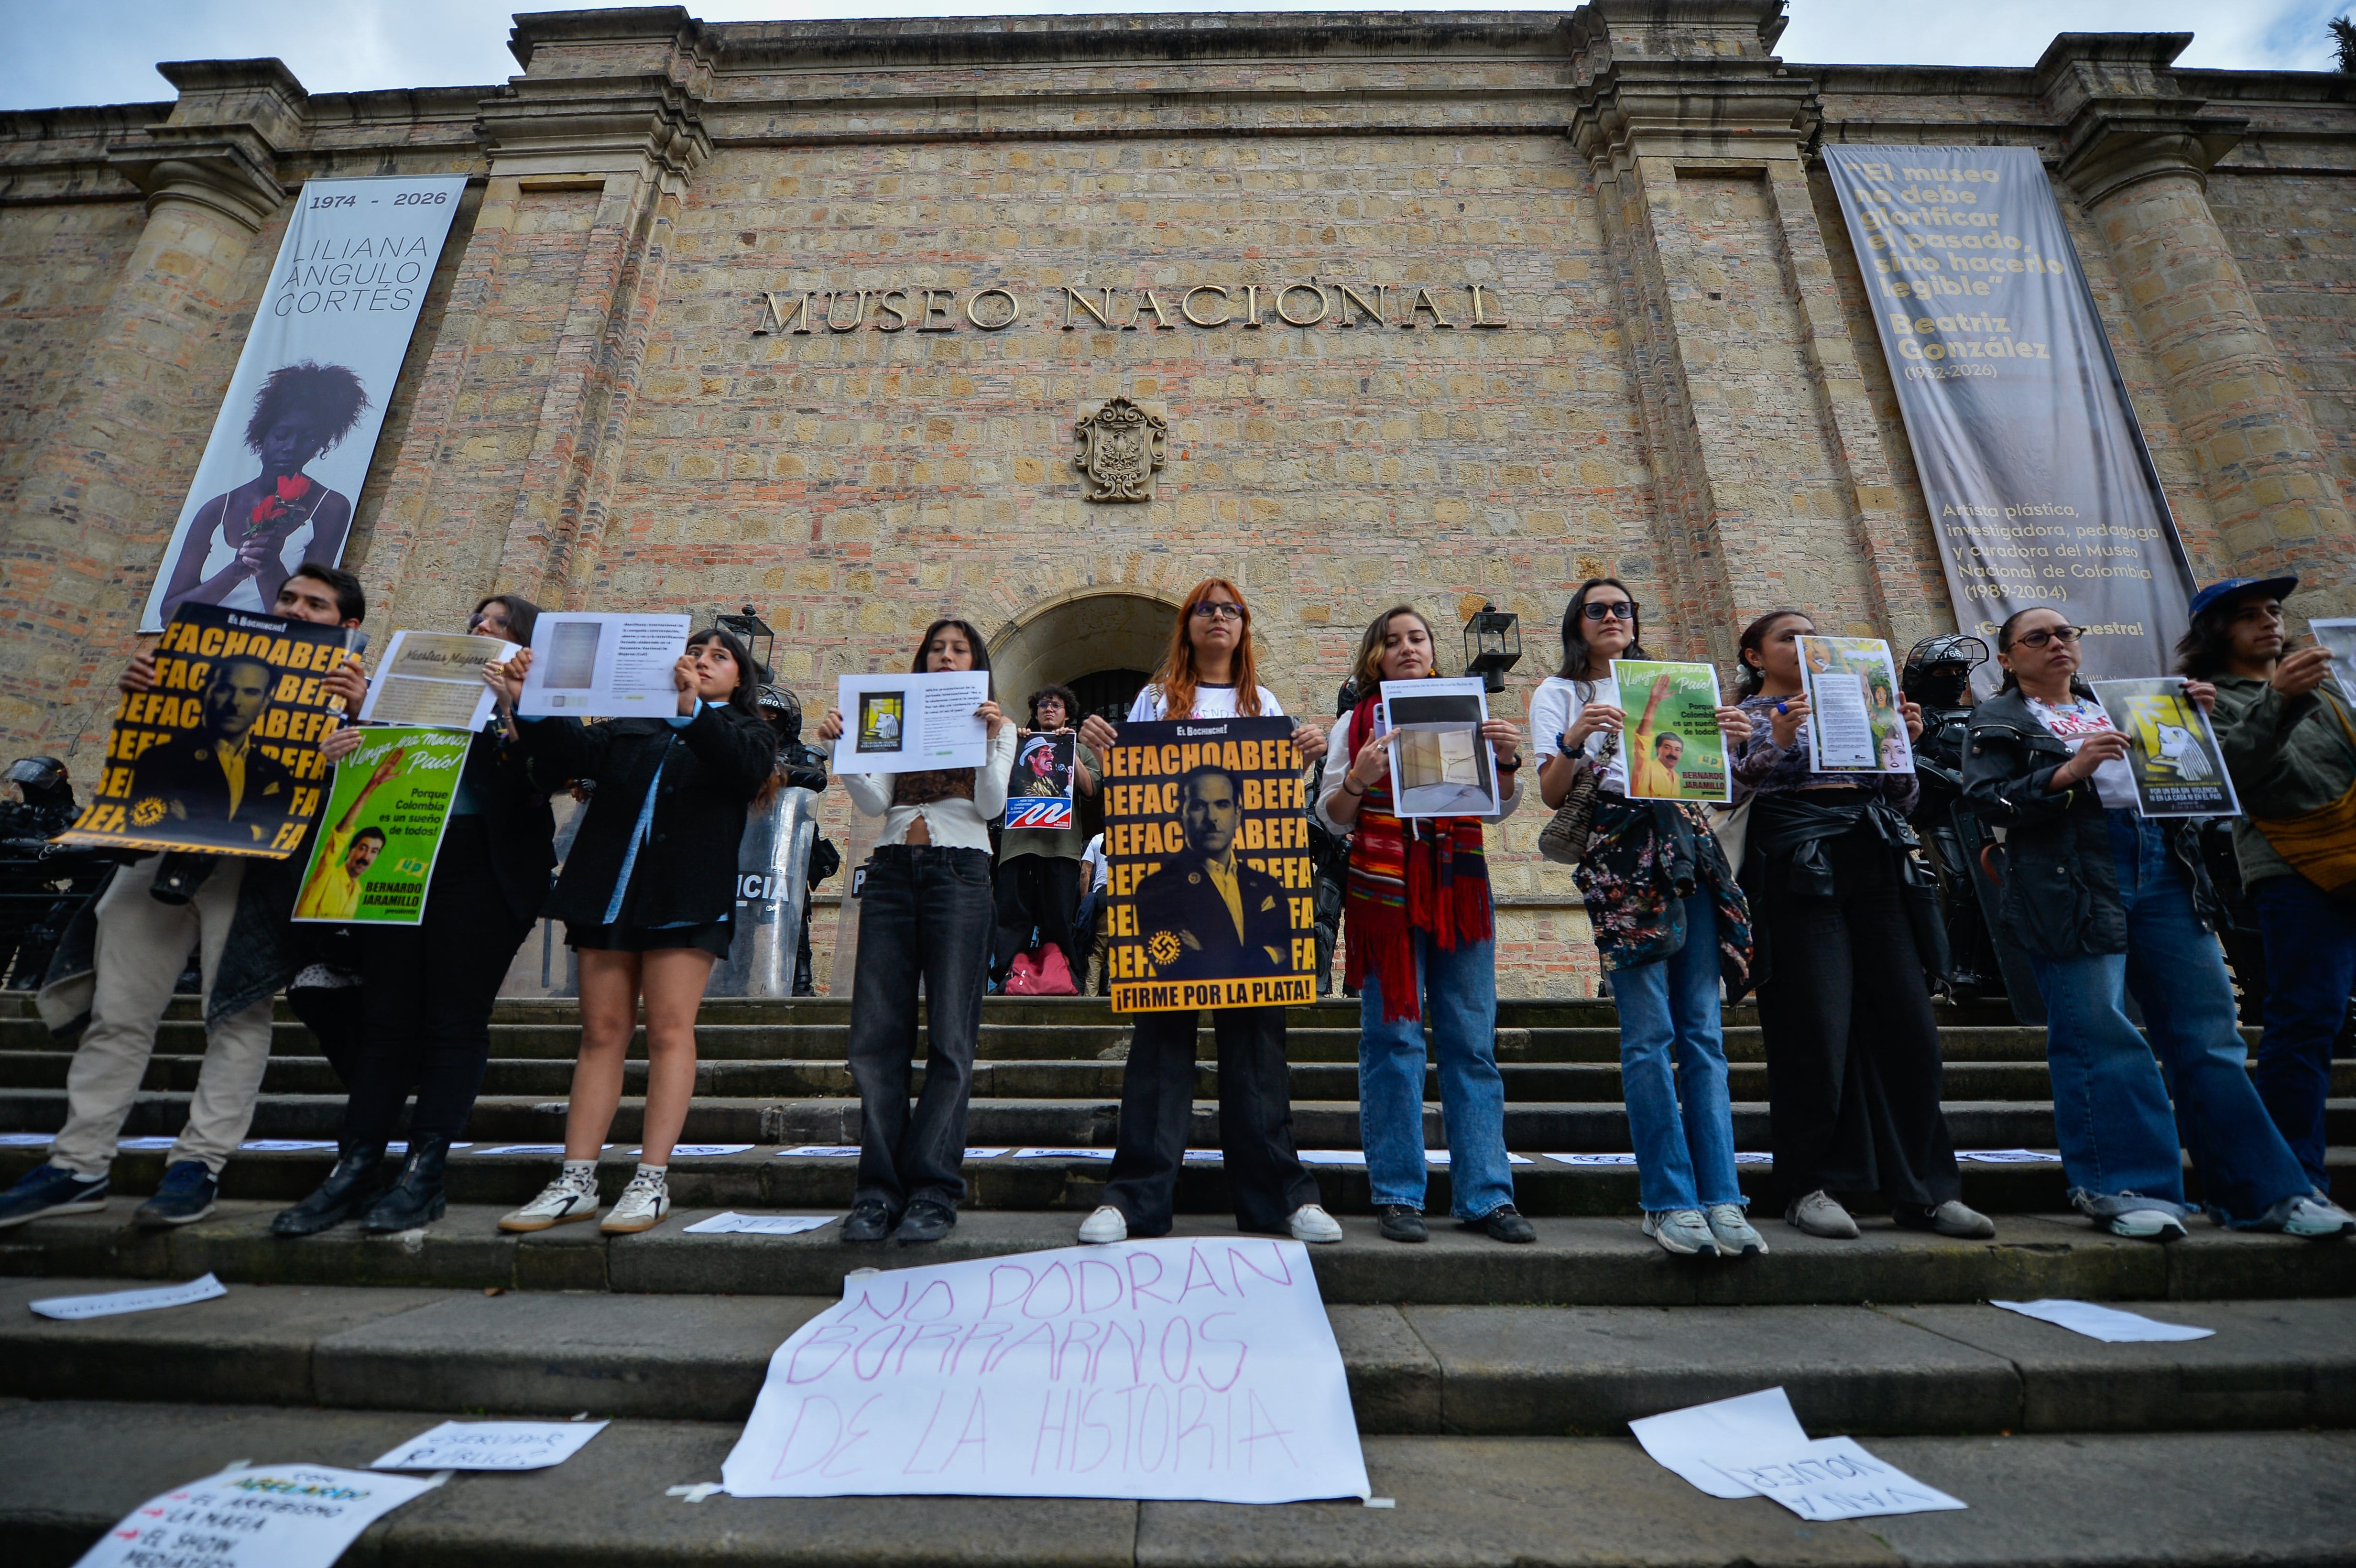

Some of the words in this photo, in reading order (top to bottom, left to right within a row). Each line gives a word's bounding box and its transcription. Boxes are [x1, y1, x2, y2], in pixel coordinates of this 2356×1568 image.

[1903, 167, 1999, 183] museo
[309, 195, 356, 209] 1974
[393, 192, 447, 206] 2026
[1855, 188, 1899, 203] no
[1901, 185, 1977, 204] debe
[1861, 207, 1999, 230] glorificar
[293, 237, 427, 262] LILIANA
[1868, 232, 1895, 249] el
[1904, 230, 2031, 253] pasado,
[1874, 252, 1940, 273] sino
[1948, 252, 2063, 274] hacerlo
[282, 262, 420, 289] ANGULO
[1881, 276, 2002, 300] legible"
[275, 285, 413, 316] CORTÉS
[753, 288, 1020, 336] MUSEO
[1061, 283, 1509, 330] NACIONAL
[1889, 312, 2011, 335] Beatriz
[1898, 336, 2051, 360] González
[1905, 364, 1997, 381] (1932-2026)
[1943, 504, 1998, 517] Artista
[2005, 503, 2079, 520] plástica,
[1948, 524, 2070, 540] investigadora,
[2076, 524, 2160, 541] pedagoga
[1952, 547, 1963, 560] y
[1970, 545, 2049, 558] curadora
[2055, 544, 2080, 556] del
[2087, 544, 2138, 558] Museo
[1958, 565, 2036, 578] Nacional
[2043, 565, 2065, 578] de
[2071, 564, 2152, 579] Colombia
[1965, 585, 2067, 602] (1989-2004)
[2080, 621, 2144, 636] aestra!
[399, 650, 447, 663] Nuestras
[1177, 726, 1186, 736] EL
[1187, 724, 1227, 737] BOCHINCHE!
[407, 751, 464, 775] País!
[1682, 771, 1724, 780] BERNARDO
[411, 788, 448, 800] Porque
[396, 800, 444, 812] Colombia
[393, 815, 406, 823] un
[408, 813, 440, 824] sueño
[389, 826, 402, 836] de
[405, 826, 438, 836] todos!
[366, 882, 422, 894] BERNARDO
[362, 894, 419, 907] JARAMILLO
[1116, 986, 1178, 1013] ¡FIRME
[1184, 984, 1221, 1007] POR
[1227, 982, 1249, 1004] LA
[1253, 980, 1311, 1002] PLATA!
[837, 1279, 956, 1324] NO
[982, 1237, 1293, 1321] PODRÁN
[786, 1312, 1248, 1393] BORRARNOS
[771, 1393, 884, 1481] DE
[903, 1386, 988, 1475] LA
[1031, 1382, 1299, 1477] HISTORIA
[1729, 1454, 1885, 1489] VOLVER
[1822, 1488, 1936, 1511] VAN
